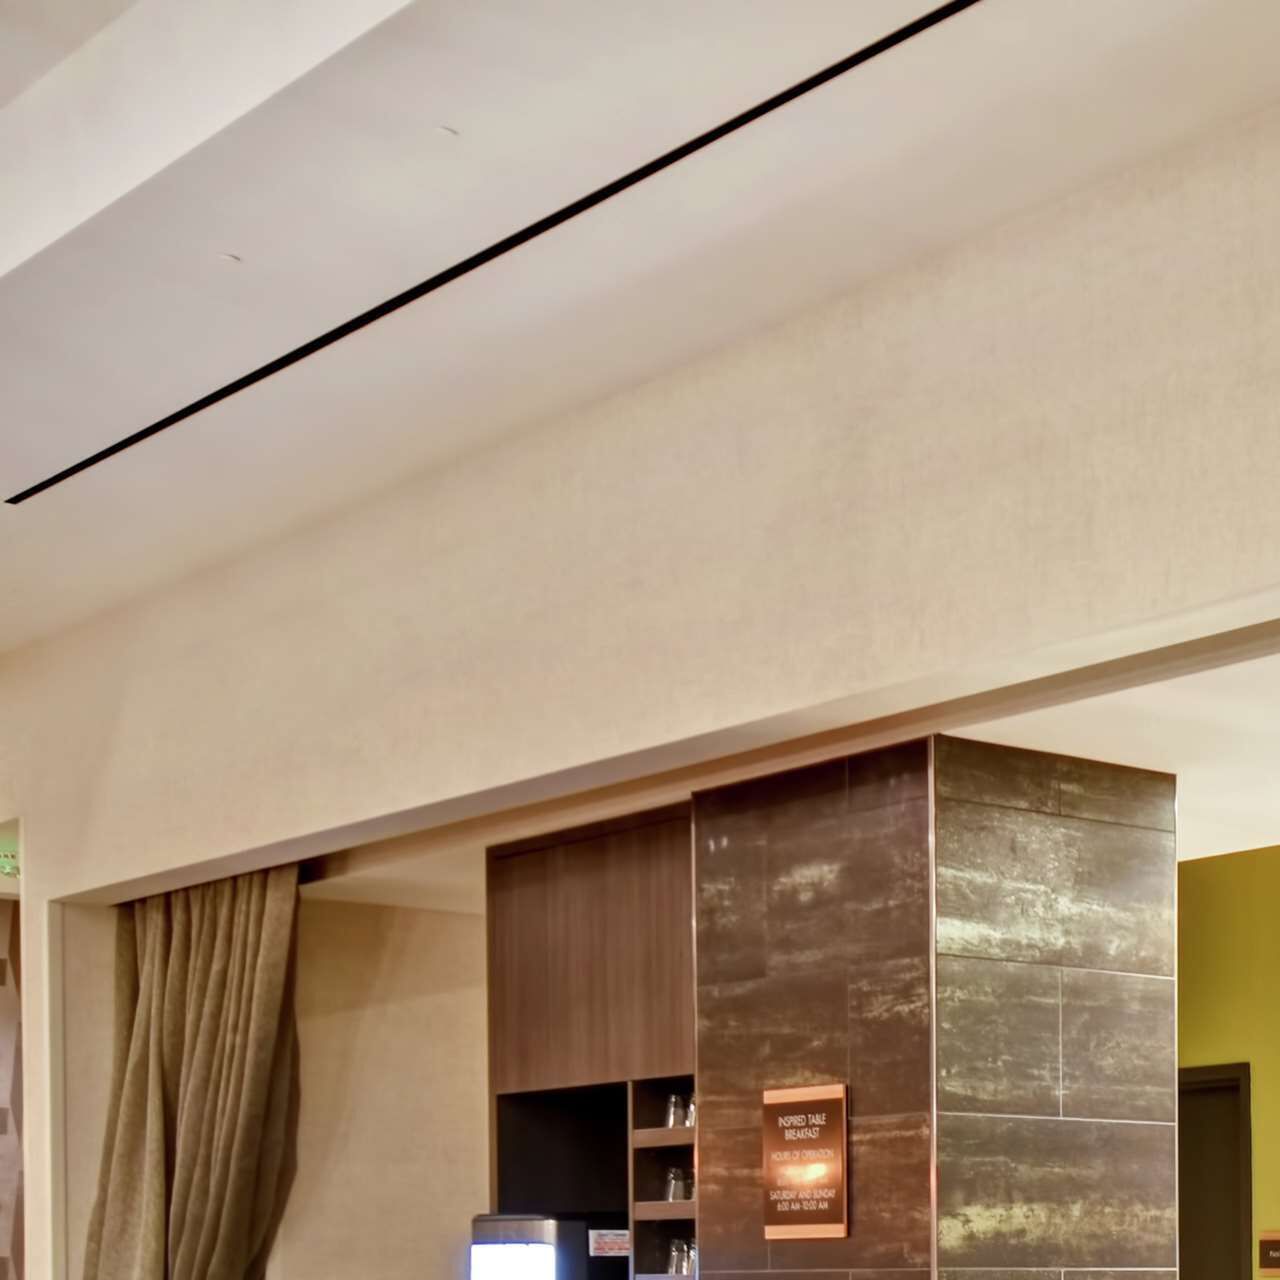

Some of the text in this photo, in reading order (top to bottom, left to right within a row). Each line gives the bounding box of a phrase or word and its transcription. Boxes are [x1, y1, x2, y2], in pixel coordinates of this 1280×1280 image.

[778, 1113, 827, 1127] INSPIRED TABLE
[784, 1127, 820, 1140] BREAKFAST
[769, 1188, 836, 1200] SATURDAY AND SUNDAY
